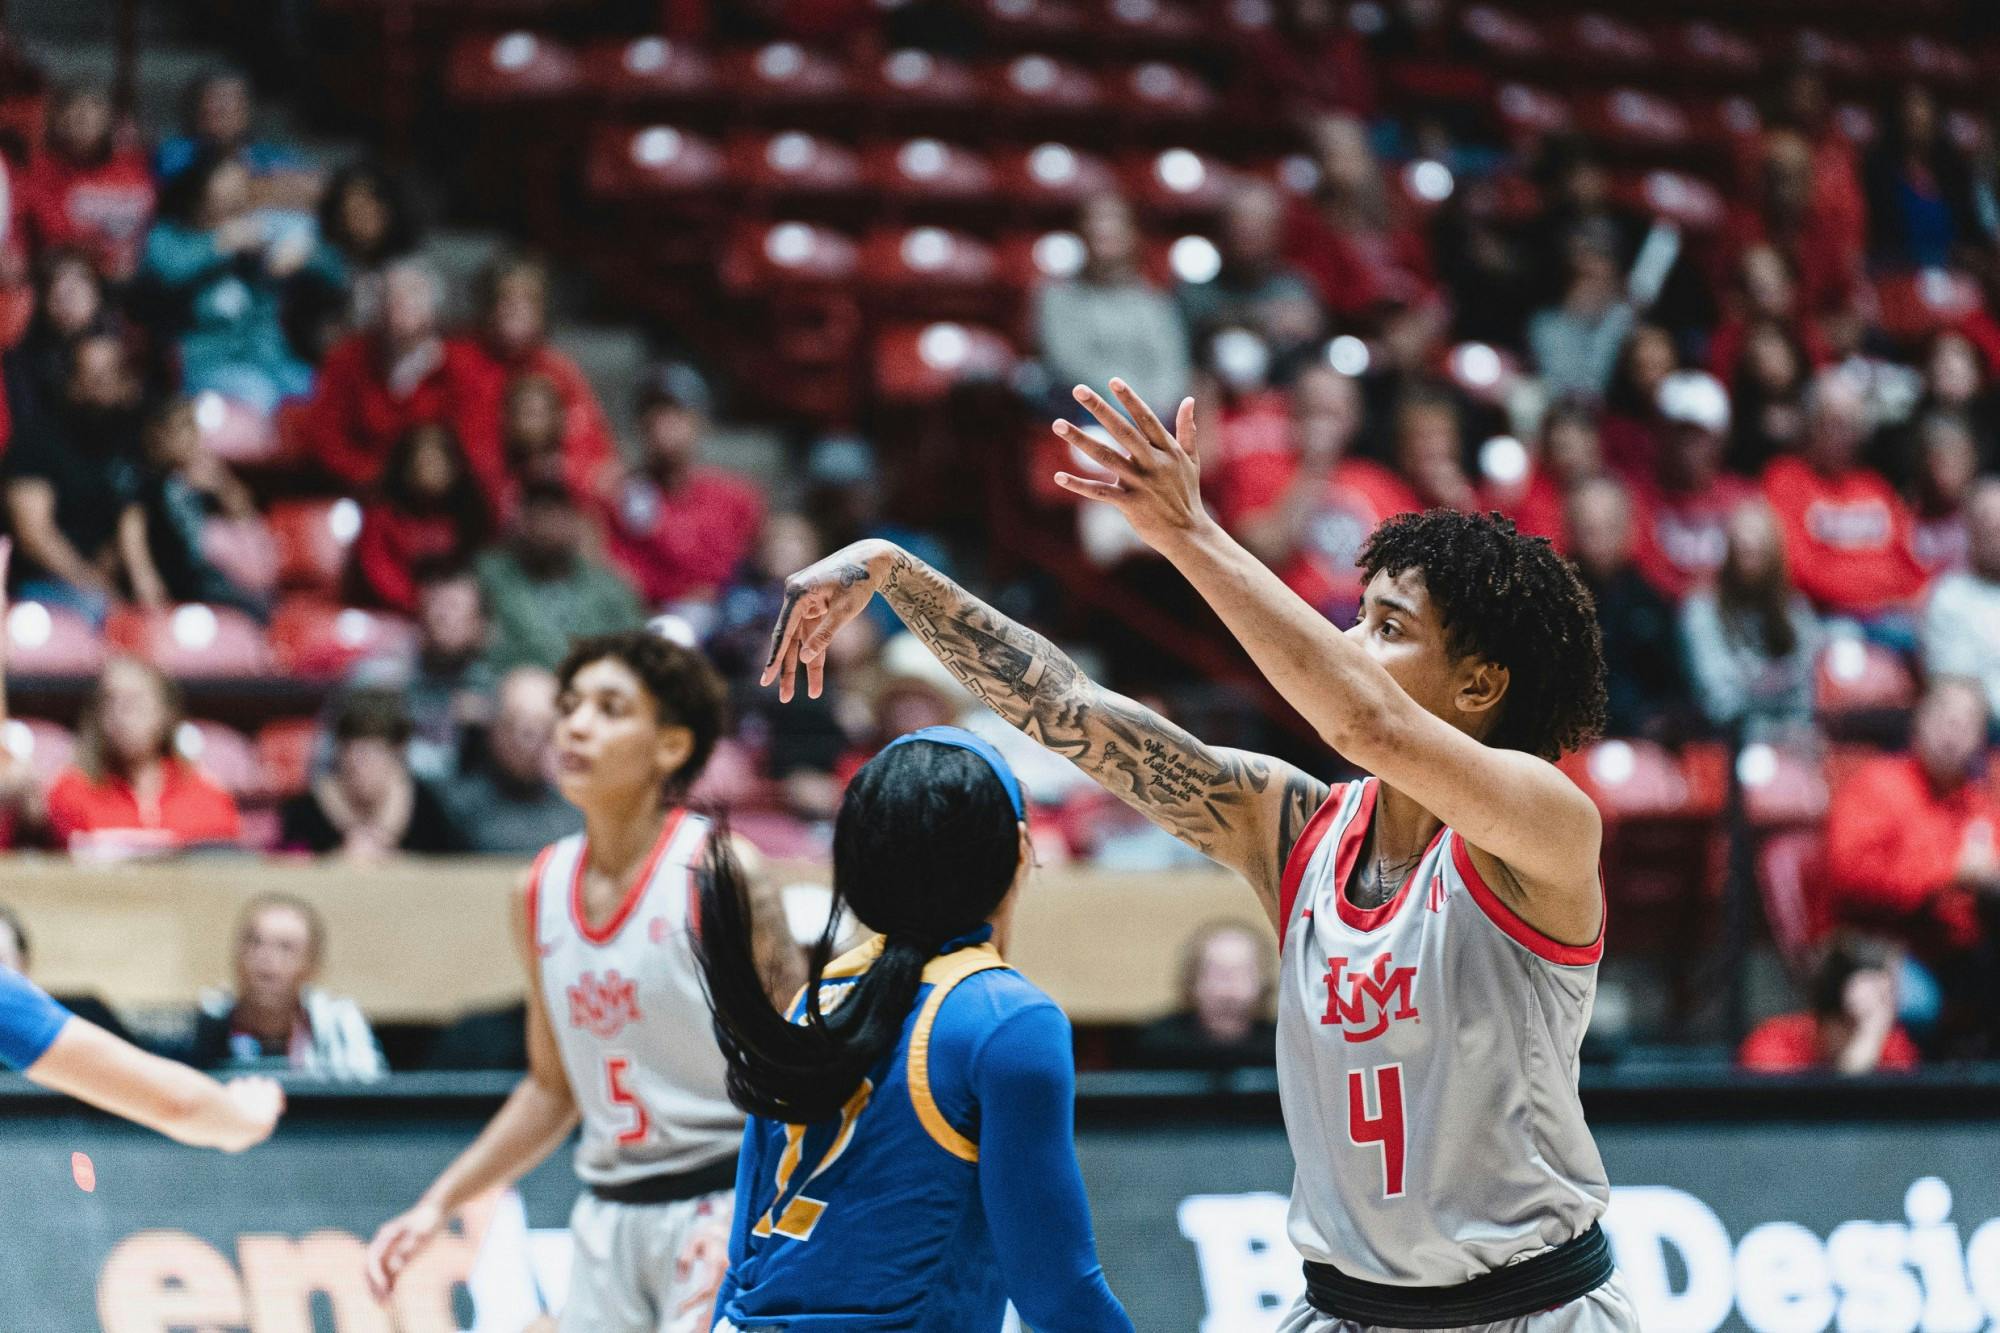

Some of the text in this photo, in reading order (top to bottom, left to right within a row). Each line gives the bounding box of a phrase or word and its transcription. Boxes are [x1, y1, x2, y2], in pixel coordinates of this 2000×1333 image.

[606, 1055, 651, 1145] 5
[1347, 1061, 1408, 1200] 4
[1609, 1176, 2000, 1333] Desi
